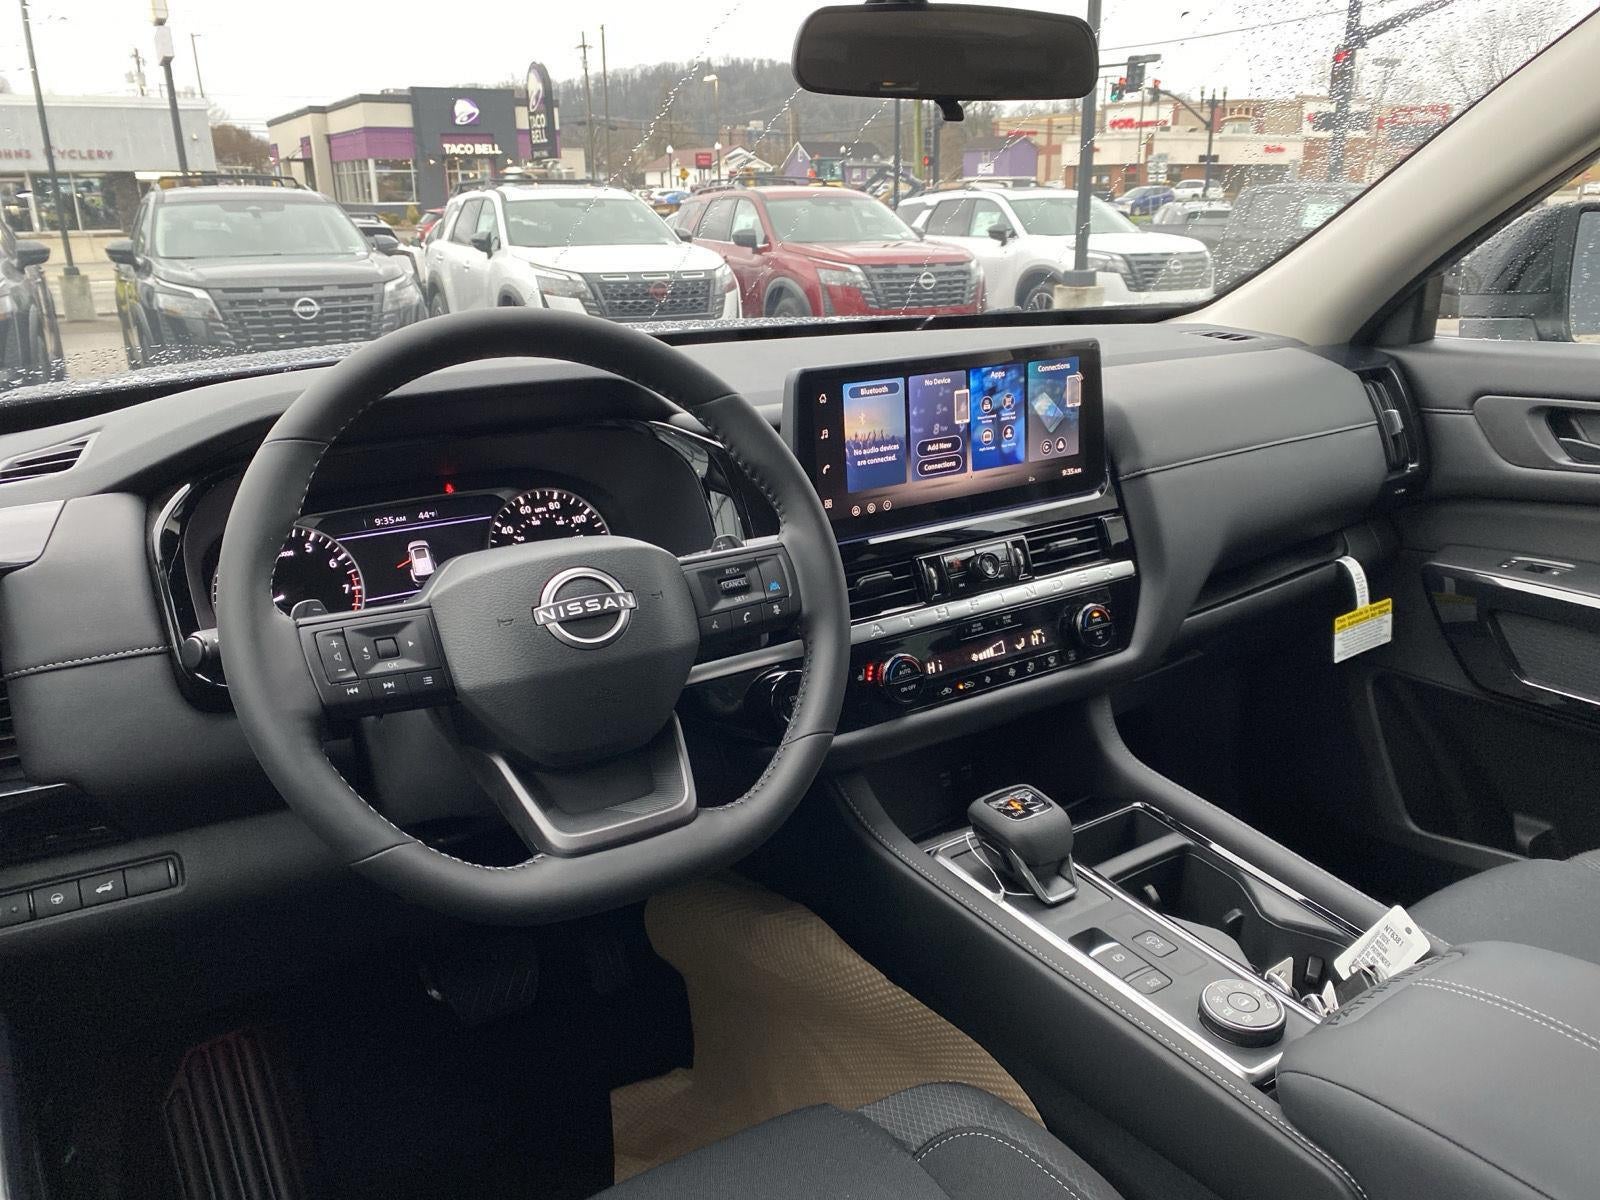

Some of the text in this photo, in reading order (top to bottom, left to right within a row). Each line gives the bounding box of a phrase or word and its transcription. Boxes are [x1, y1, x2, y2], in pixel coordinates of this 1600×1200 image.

[530, 113, 546, 129] TACO
[531, 128, 549, 144] BELL
[443, 143, 503, 155] TACO BELL
[1037, 363, 1071, 372] Connections
[990, 370, 1005, 379] Apps
[934, 377, 951, 385] Device
[860, 385, 889, 395] Bluetooth
[853, 443, 900, 456] No audio devices
[927, 442, 952, 451] Add New
[867, 454, 897, 465] connected.
[924, 461, 956, 471] Connections
[1062, 468, 1074, 476] 9:35
[520, 505, 532, 515] 60
[548, 501, 560, 510] 80
[374, 516, 395, 526] 9:35
[571, 514, 587, 524] 100
[501, 526, 514, 535] 40
[304, 542, 313, 553] 5
[328, 558, 337, 568] 6
[342, 583, 349, 594] 7
[724, 579, 748, 589] CANCEL
[538, 594, 634, 623] NISSAN
[387, 661, 399, 669] OK
[927, 659, 943, 674] Hi
[1384, 924, 1404, 947] NT6381
